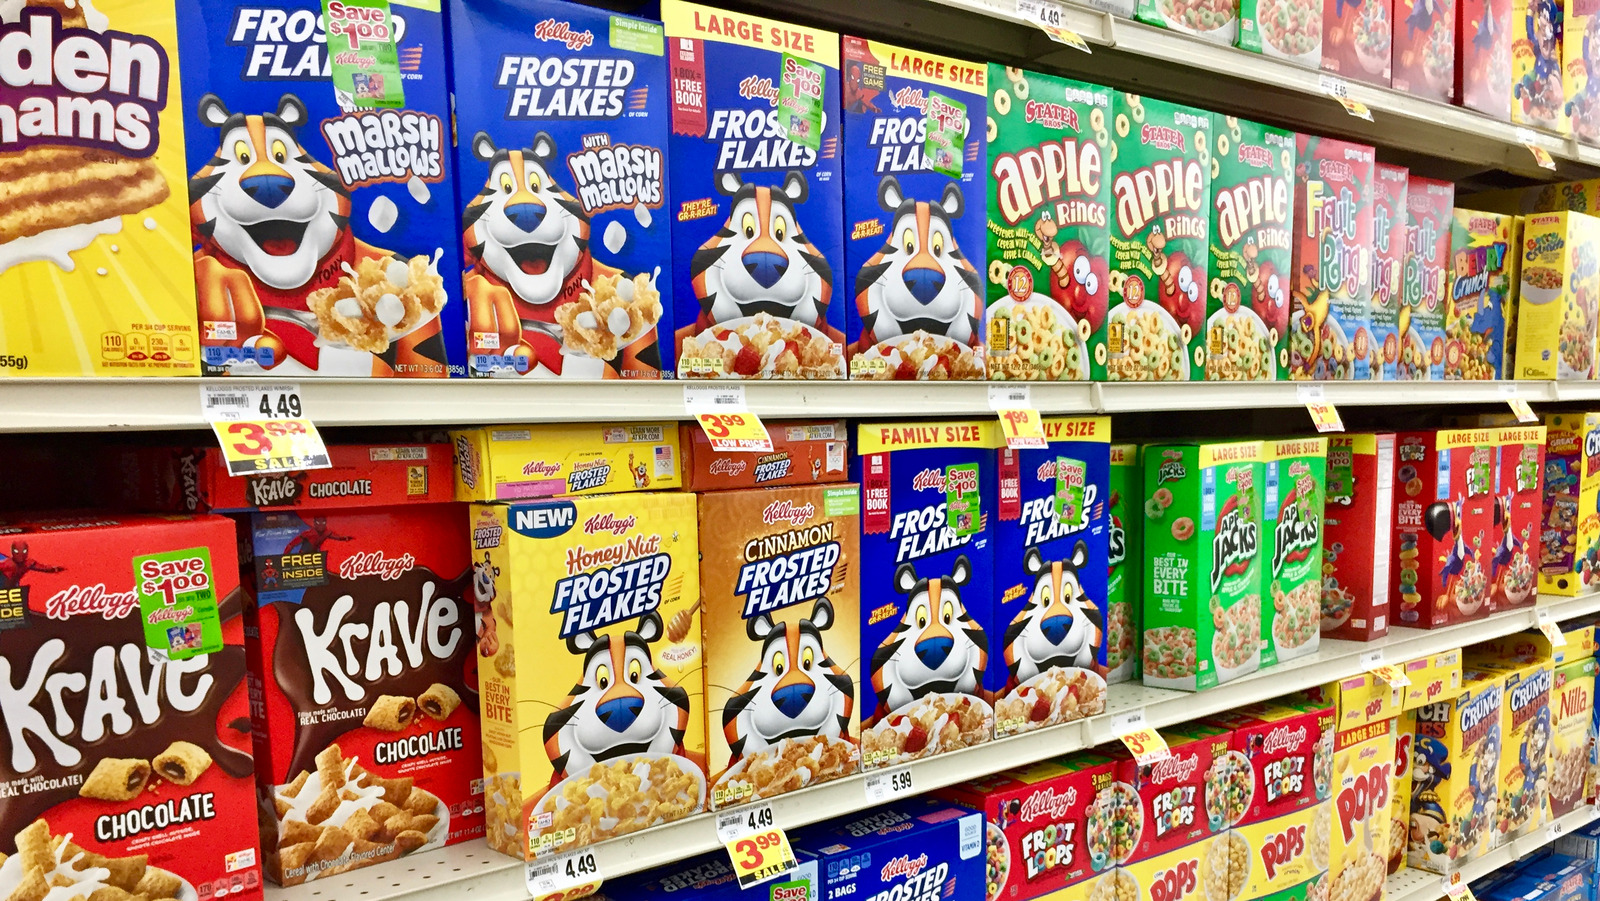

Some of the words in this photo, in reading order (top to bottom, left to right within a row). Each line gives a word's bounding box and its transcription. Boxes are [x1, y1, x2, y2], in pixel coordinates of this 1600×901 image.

[329, 2, 385, 22] Save
[535, 19, 593, 49] Kellogg's
[615, 18, 638, 31] Simple
[639, 23, 658, 34] Inside
[694, 11, 764, 43] LARGE
[771, 28, 815, 53] SIZE
[0, 15, 160, 101] den
[335, 52, 376, 71] Kellogg's
[863, 64, 884, 75] FREE
[891, 53, 945, 79] LARGE
[949, 65, 985, 86] SIZE
[499, 57, 635, 87] FROSTED
[786, 58, 821, 84] Save
[863, 77, 884, 88] GAME
[680, 79, 703, 93] FREE
[509, 88, 624, 118] FLAKES
[675, 92, 703, 107] BOOK
[931, 97, 963, 119] Save
[1026, 100, 1081, 133] STATER
[324, 112, 439, 156] MARSH
[583, 135, 608, 149] WITH
[1141, 124, 1186, 153] STATER
[337, 145, 441, 185] MALLOWS
[569, 147, 662, 185] MARSH
[717, 141, 817, 170] FLAKES
[579, 175, 662, 212] MALLOWS
[681, 198, 713, 211] THEY'RE
[317, 256, 345, 284] TONY
[1455, 242, 1507, 277] BERRY
[562, 274, 584, 300] TONY
[1014, 276, 1026, 292] 12
[1453, 266, 1489, 300] Crunch
[131, 323, 145, 331] PER
[105, 336, 122, 347] 110
[395, 364, 407, 374] NET
[408, 365, 419, 374] WT
[259, 394, 302, 418] 4.49
[881, 426, 940, 445] FAMILY
[946, 426, 980, 441] SIZE
[1066, 421, 1096, 437] SIZE
[1447, 432, 1471, 444] LARGE
[1474, 431, 1490, 442] SIZE
[716, 438, 737, 448] LOW
[740, 439, 765, 448] PRICE
[1212, 449, 1239, 461] LARGE
[1240, 447, 1257, 459] SIZE
[1276, 443, 1302, 456] LARGE
[1303, 441, 1320, 453] SIZE
[522, 460, 561, 476] Kellogg's
[569, 465, 611, 482] FROSTED
[709, 459, 747, 477] Kellogg's
[949, 470, 976, 481] Save
[1060, 461, 1083, 475] Save
[1158, 467, 1186, 486] JACKS
[309, 479, 372, 498] CHOCOLATE
[571, 477, 607, 492] FLAKES
[516, 507, 573, 531] NEW!
[584, 513, 636, 535] Kellogg's
[763, 501, 814, 524] Kellogg's
[474, 527, 502, 541] FROSTED
[475, 536, 500, 550] FLAKES
[745, 522, 833, 563] CINNAMON
[281, 553, 322, 568] FREE
[341, 552, 415, 581] Kellogg's
[566, 545, 624, 576] Honey
[626, 535, 661, 560] Nut
[1154, 557, 1175, 568] BEST
[1177, 558, 1189, 568] IN
[1212, 522, 1258, 593] JACKS
[142, 559, 204, 579] Save
[282, 568, 323, 580] INSIDE
[738, 543, 840, 593] FROSTED
[1153, 567, 1186, 581] EVERY
[554, 554, 670, 611] FROSTED
[745, 568, 832, 616] FLAKES
[1153, 580, 1189, 597] BITE
[195, 590, 212, 601] TWO
[148, 606, 193, 624] Kellogg's
[563, 583, 662, 636] FLAKES
[662, 651, 677, 662] REAL
[676, 647, 698, 662] HONEY!
[485, 682, 499, 693] BEST
[501, 684, 510, 694] IN
[485, 692, 511, 705] EVERY
[1511, 670, 1553, 712] CRUNCH
[486, 702, 512, 723] BITE
[1461, 686, 1502, 733] CRUNCH
[1560, 686, 1587, 720] Nilla
[300, 715, 319, 726] REAL
[321, 708, 366, 722] CHOCOLATE!
[375, 728, 463, 763] CHOCOLATE
[1264, 725, 1307, 754] Kellogg's
[1341, 729, 1369, 747] LARGE
[1371, 722, 1387, 738] SIZE
[1151, 753, 1198, 785] Kellogg's
[1264, 757, 1305, 786] FROOT
[892, 771, 912, 791] 5.99
[1266, 775, 1304, 803] LOOPS
[1020, 786, 1077, 822] Kellogg's
[1153, 786, 1197, 818] FROOT
[1336, 763, 1392, 846] POPS
[97, 792, 216, 841] CHOCOLATE
[748, 807, 773, 830] 4.49
[1156, 805, 1195, 837] LOOPS
[735, 832, 781, 870] 399
[1021, 822, 1076, 859] FROOT
[284, 864, 304, 879] Cereal
[305, 862, 320, 875] with
[349, 847, 376, 863] Flavored
[375, 843, 396, 858] Center
[1026, 847, 1074, 880] LOOPS
[1260, 825, 1306, 880] POPS
[566, 853, 597, 878] 4.49
[755, 864, 786, 880] SALE
[881, 853, 928, 882] Kellogg's
[828, 888, 834, 899] 2
[835, 883, 857, 898] BAGS
[1150, 859, 1198, 901] POPS
[773, 885, 806, 899] Save
